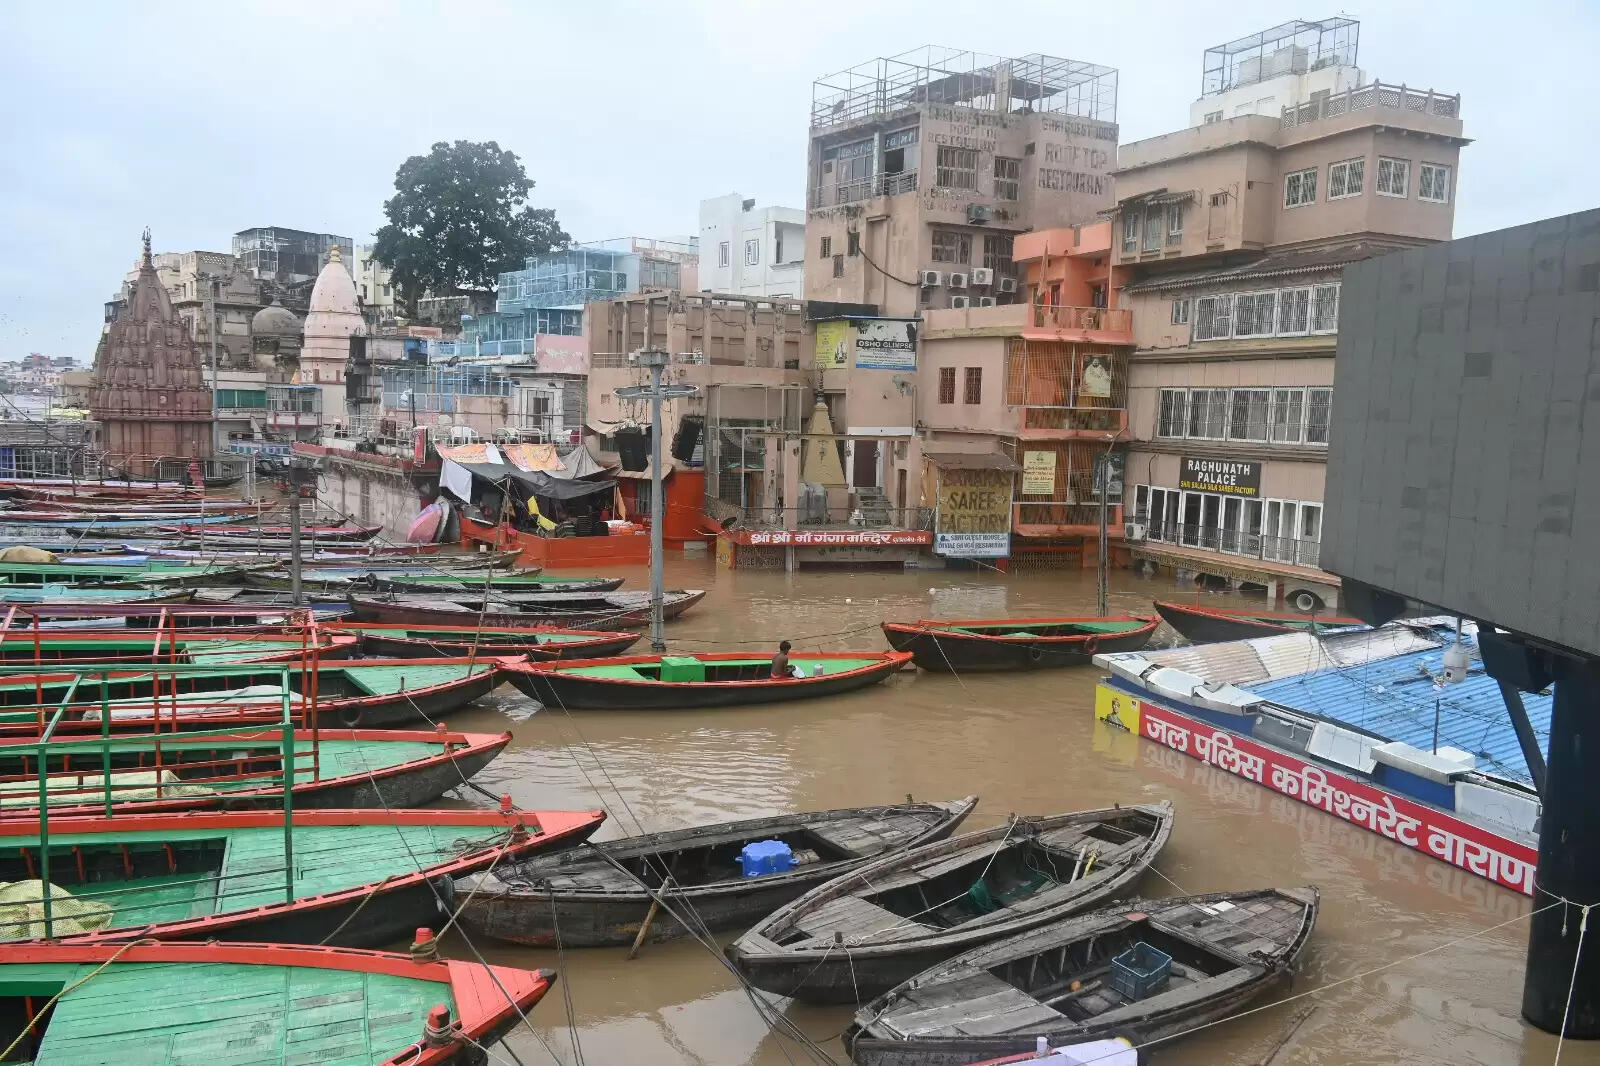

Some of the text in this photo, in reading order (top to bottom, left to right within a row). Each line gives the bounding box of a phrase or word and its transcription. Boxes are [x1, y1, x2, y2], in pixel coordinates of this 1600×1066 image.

[858, 340, 914, 350] OSHO GLIMPSE
[1188, 460, 1251, 476] RAGHUNATH
[1198, 472, 1237, 486] PALACE
[1234, 486, 1256, 495] FACTORY
[949, 491, 997, 511] SAREE
[750, 531, 771, 544] श्री
[771, 532, 791, 544] श्री
[813, 532, 845, 543] गंगा
[1145, 714, 1191, 752] जल
[1193, 730, 1266, 783] पुलिस
[1271, 765, 1423, 848] कमिश्नरेट
